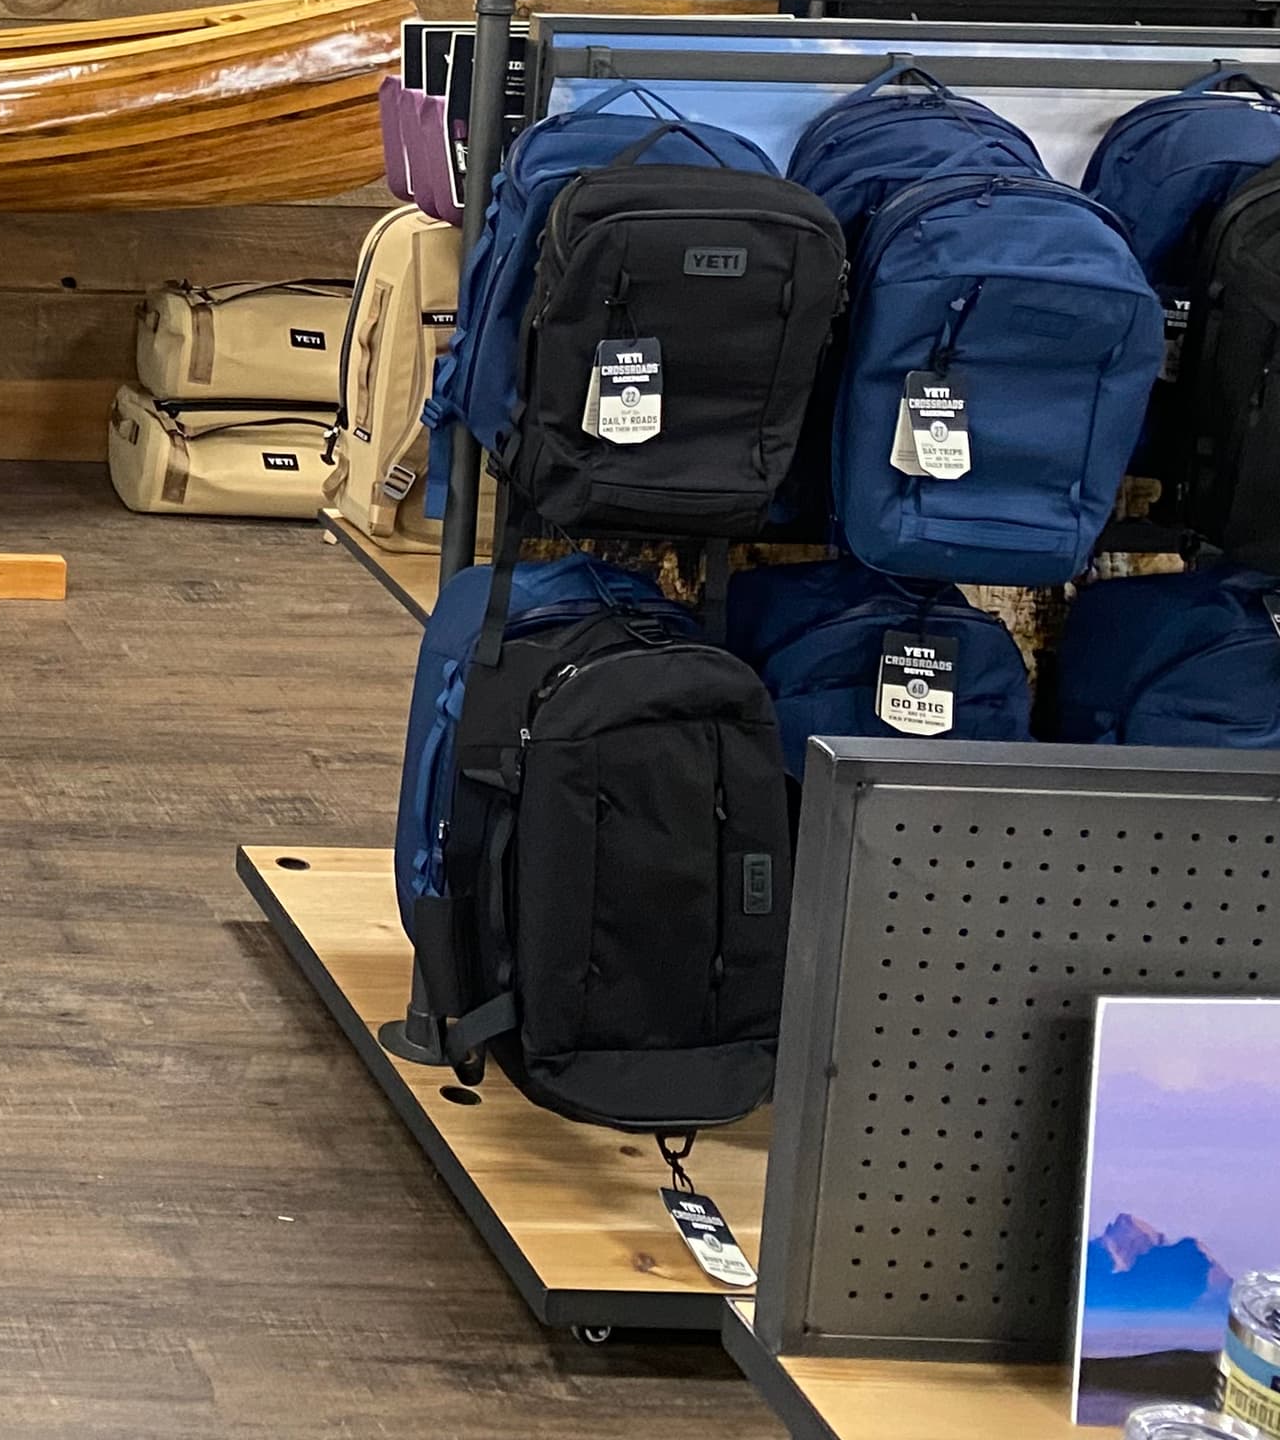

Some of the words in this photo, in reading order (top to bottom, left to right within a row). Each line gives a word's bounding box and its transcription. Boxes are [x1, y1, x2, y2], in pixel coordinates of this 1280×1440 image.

[692, 254, 740, 270] YETI
[1174, 299, 1192, 311] YE
[432, 314, 454, 323] YETI
[294, 334, 321, 345] YETI
[616, 353, 643, 363] YETI
[602, 364, 658, 376] CROSSROADS
[626, 392, 636, 402] 22
[923, 387, 950, 398] YETI
[602, 418, 627, 426] DAILY
[631, 416, 657, 424] ROADS
[267, 456, 295, 467] YETI
[904, 646, 935, 659] YETI
[885, 656, 953, 671] CROSSROADS
[912, 684, 924, 694] 60
[891, 699, 911, 709] GO
[917, 702, 944, 713] BIG
[679, 1201, 707, 1215] YETI
